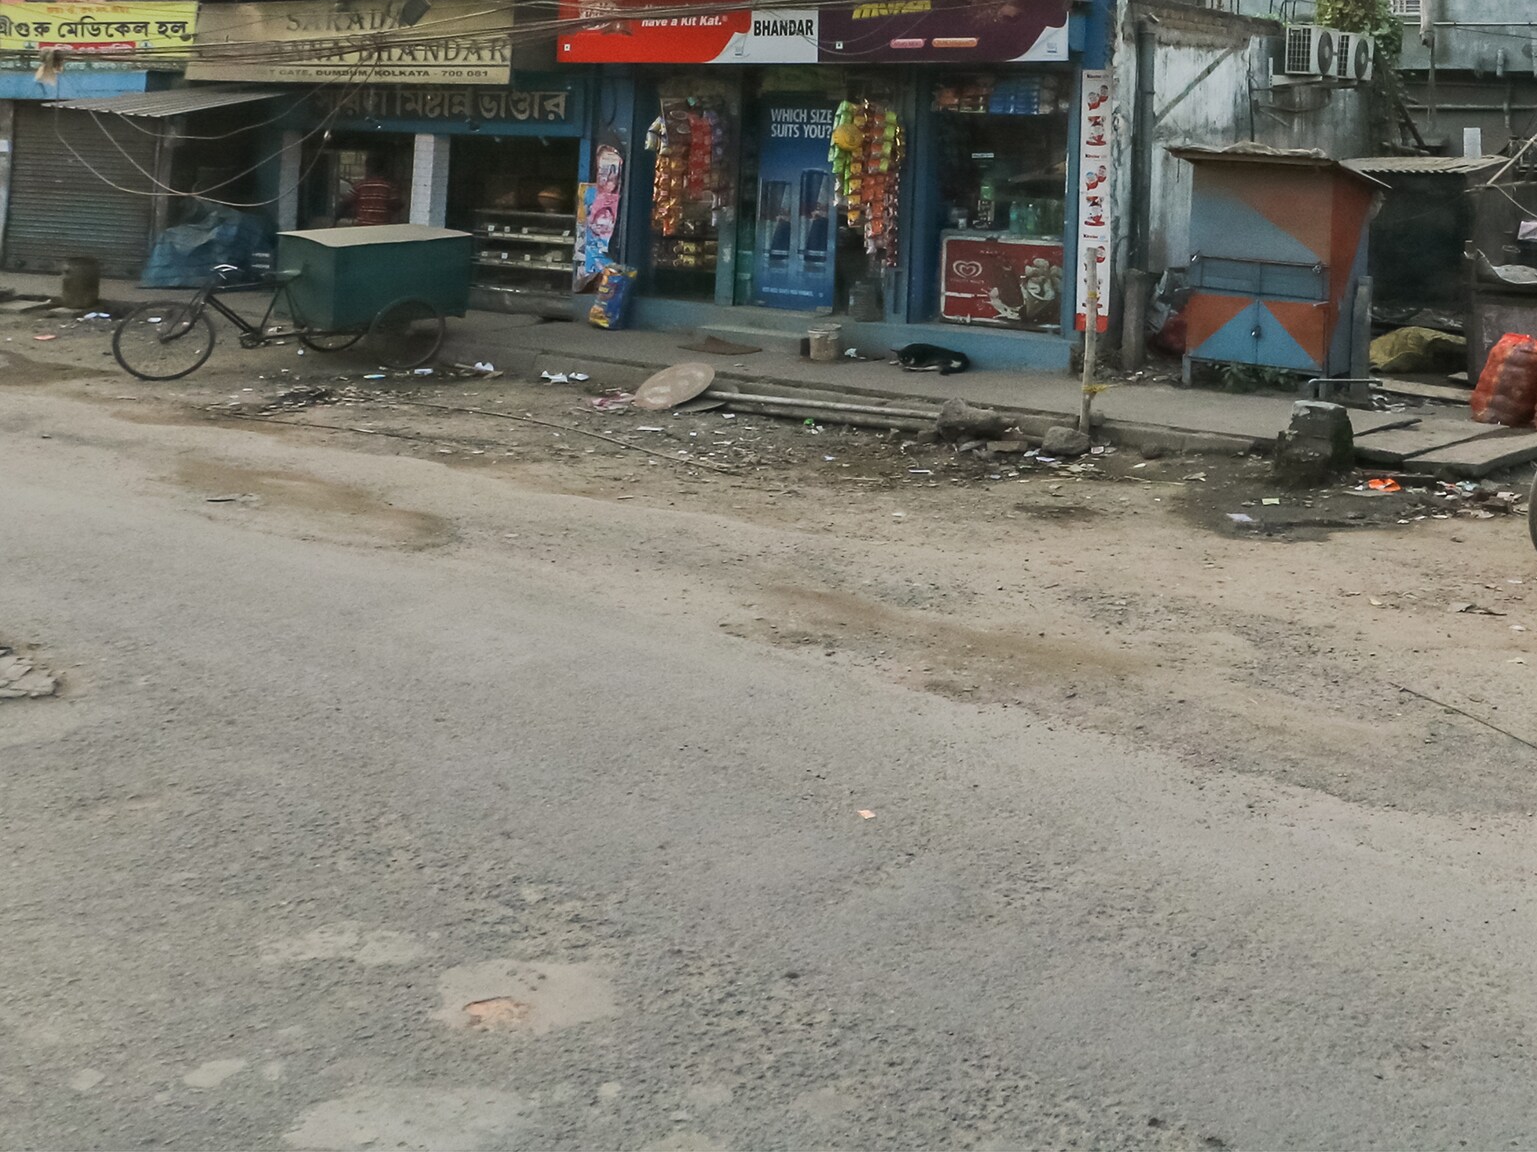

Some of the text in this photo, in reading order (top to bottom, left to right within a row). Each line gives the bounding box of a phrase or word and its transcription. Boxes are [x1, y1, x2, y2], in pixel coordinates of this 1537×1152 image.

[58, 16, 150, 38] মেডিকেল
[155, 21, 188, 39] হল
[754, 19, 813, 36] BHANDAR
[374, 69, 430, 77] KOLKATA
[771, 109, 833, 124] WHICH SIZE
[771, 124, 832, 139] SUITS YOU?
